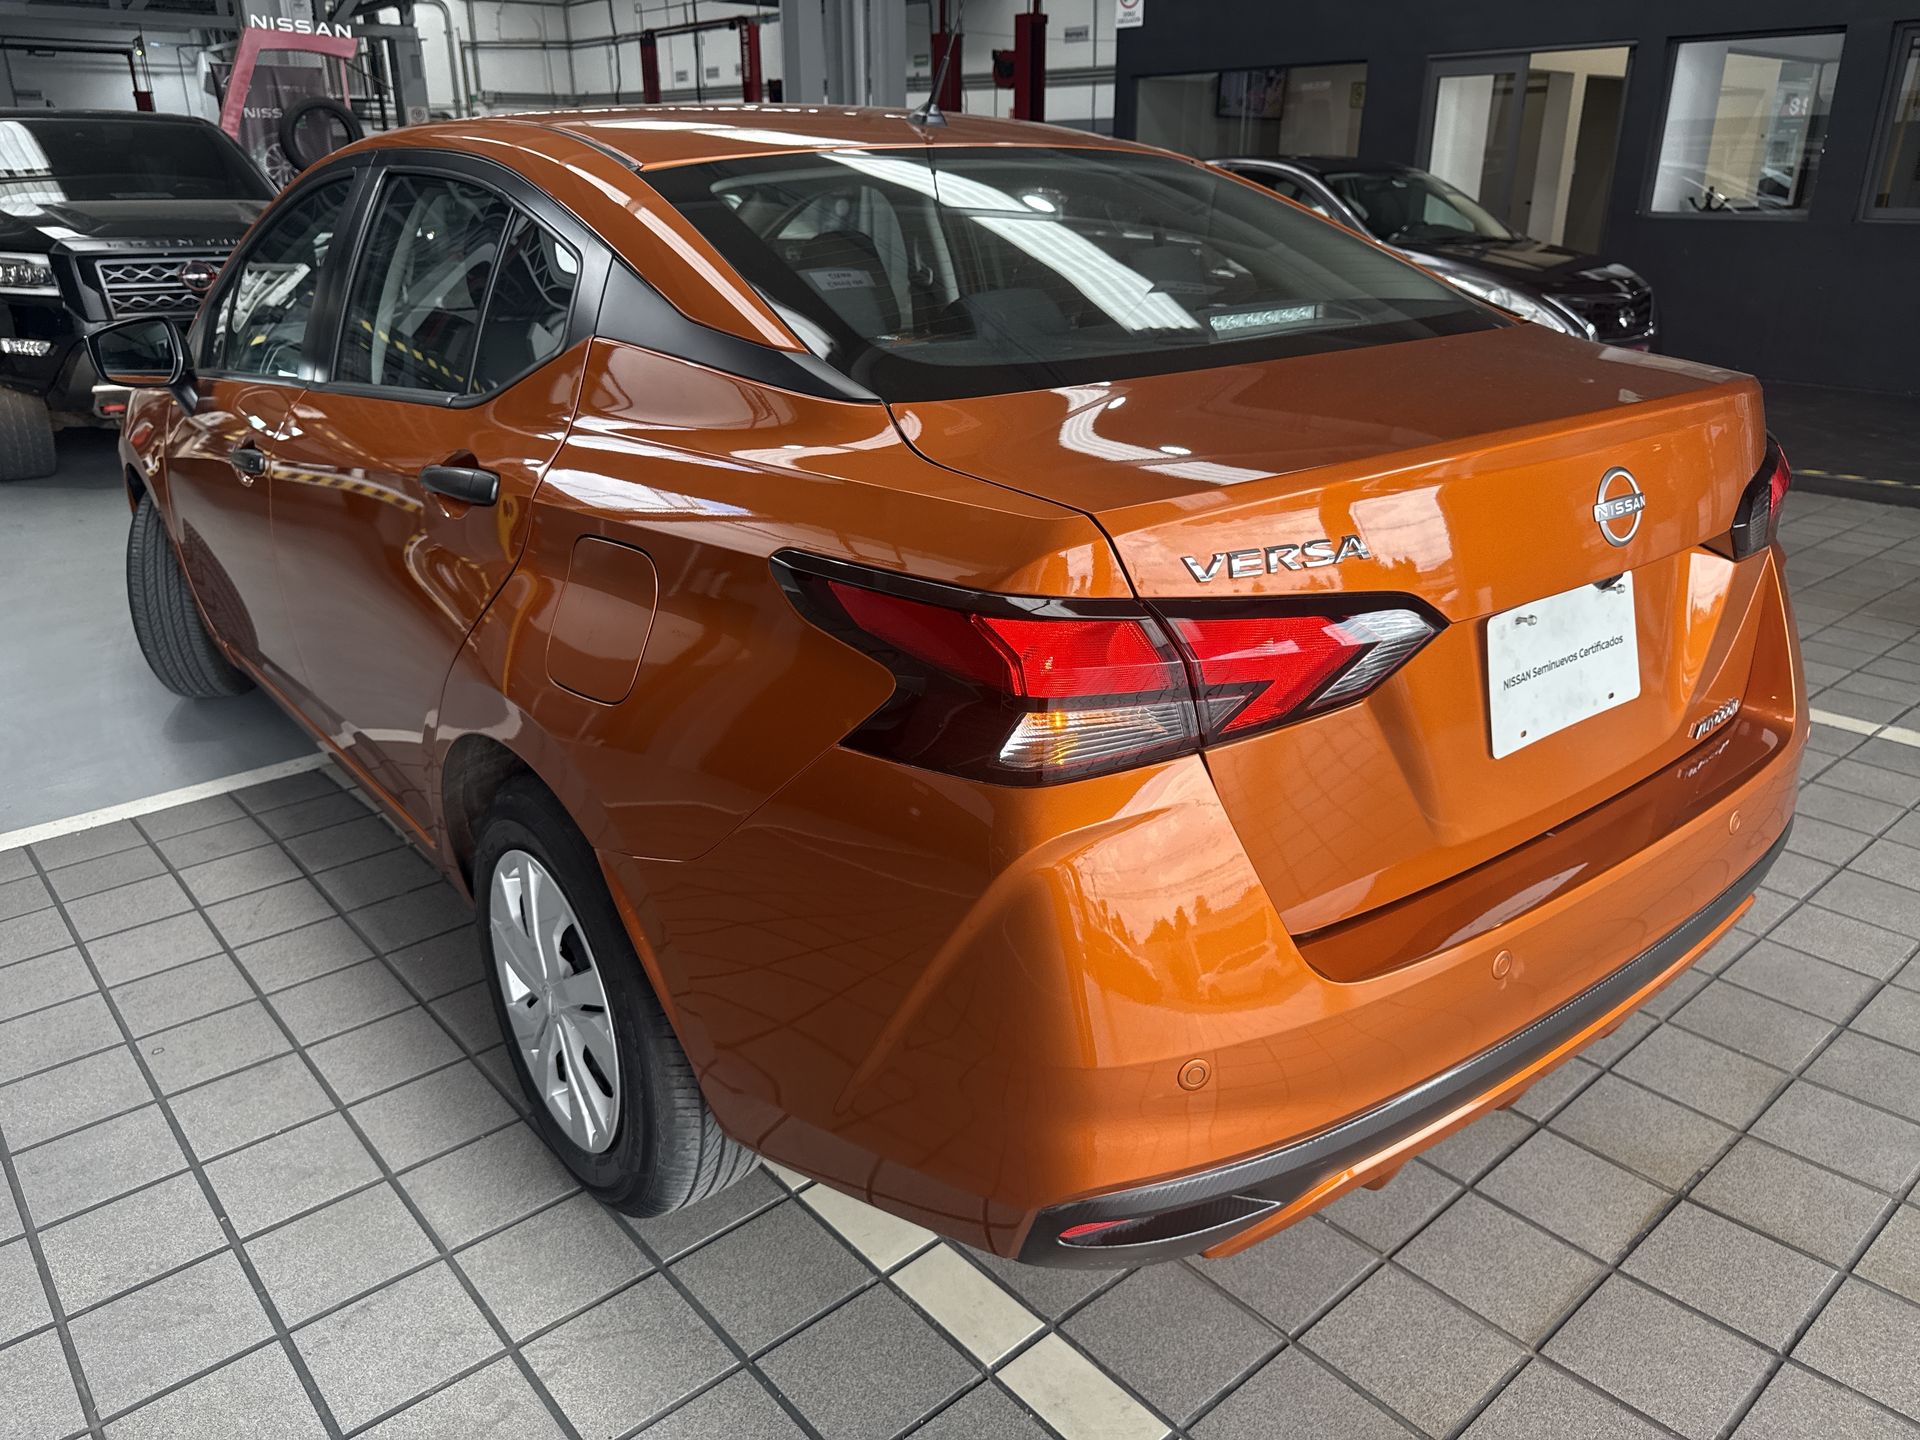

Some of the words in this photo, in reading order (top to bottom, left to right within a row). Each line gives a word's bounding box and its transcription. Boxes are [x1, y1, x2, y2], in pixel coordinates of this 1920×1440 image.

[250, 14, 352, 39] NISSAN
[243, 106, 283, 119] NISS
[1597, 495, 1646, 519] NISSAN
[1180, 534, 1371, 583] VERSA
[1503, 669, 1532, 691] NISSAN
[1532, 652, 1578, 679] Seminuevos
[1579, 635, 1624, 659] Certificados
